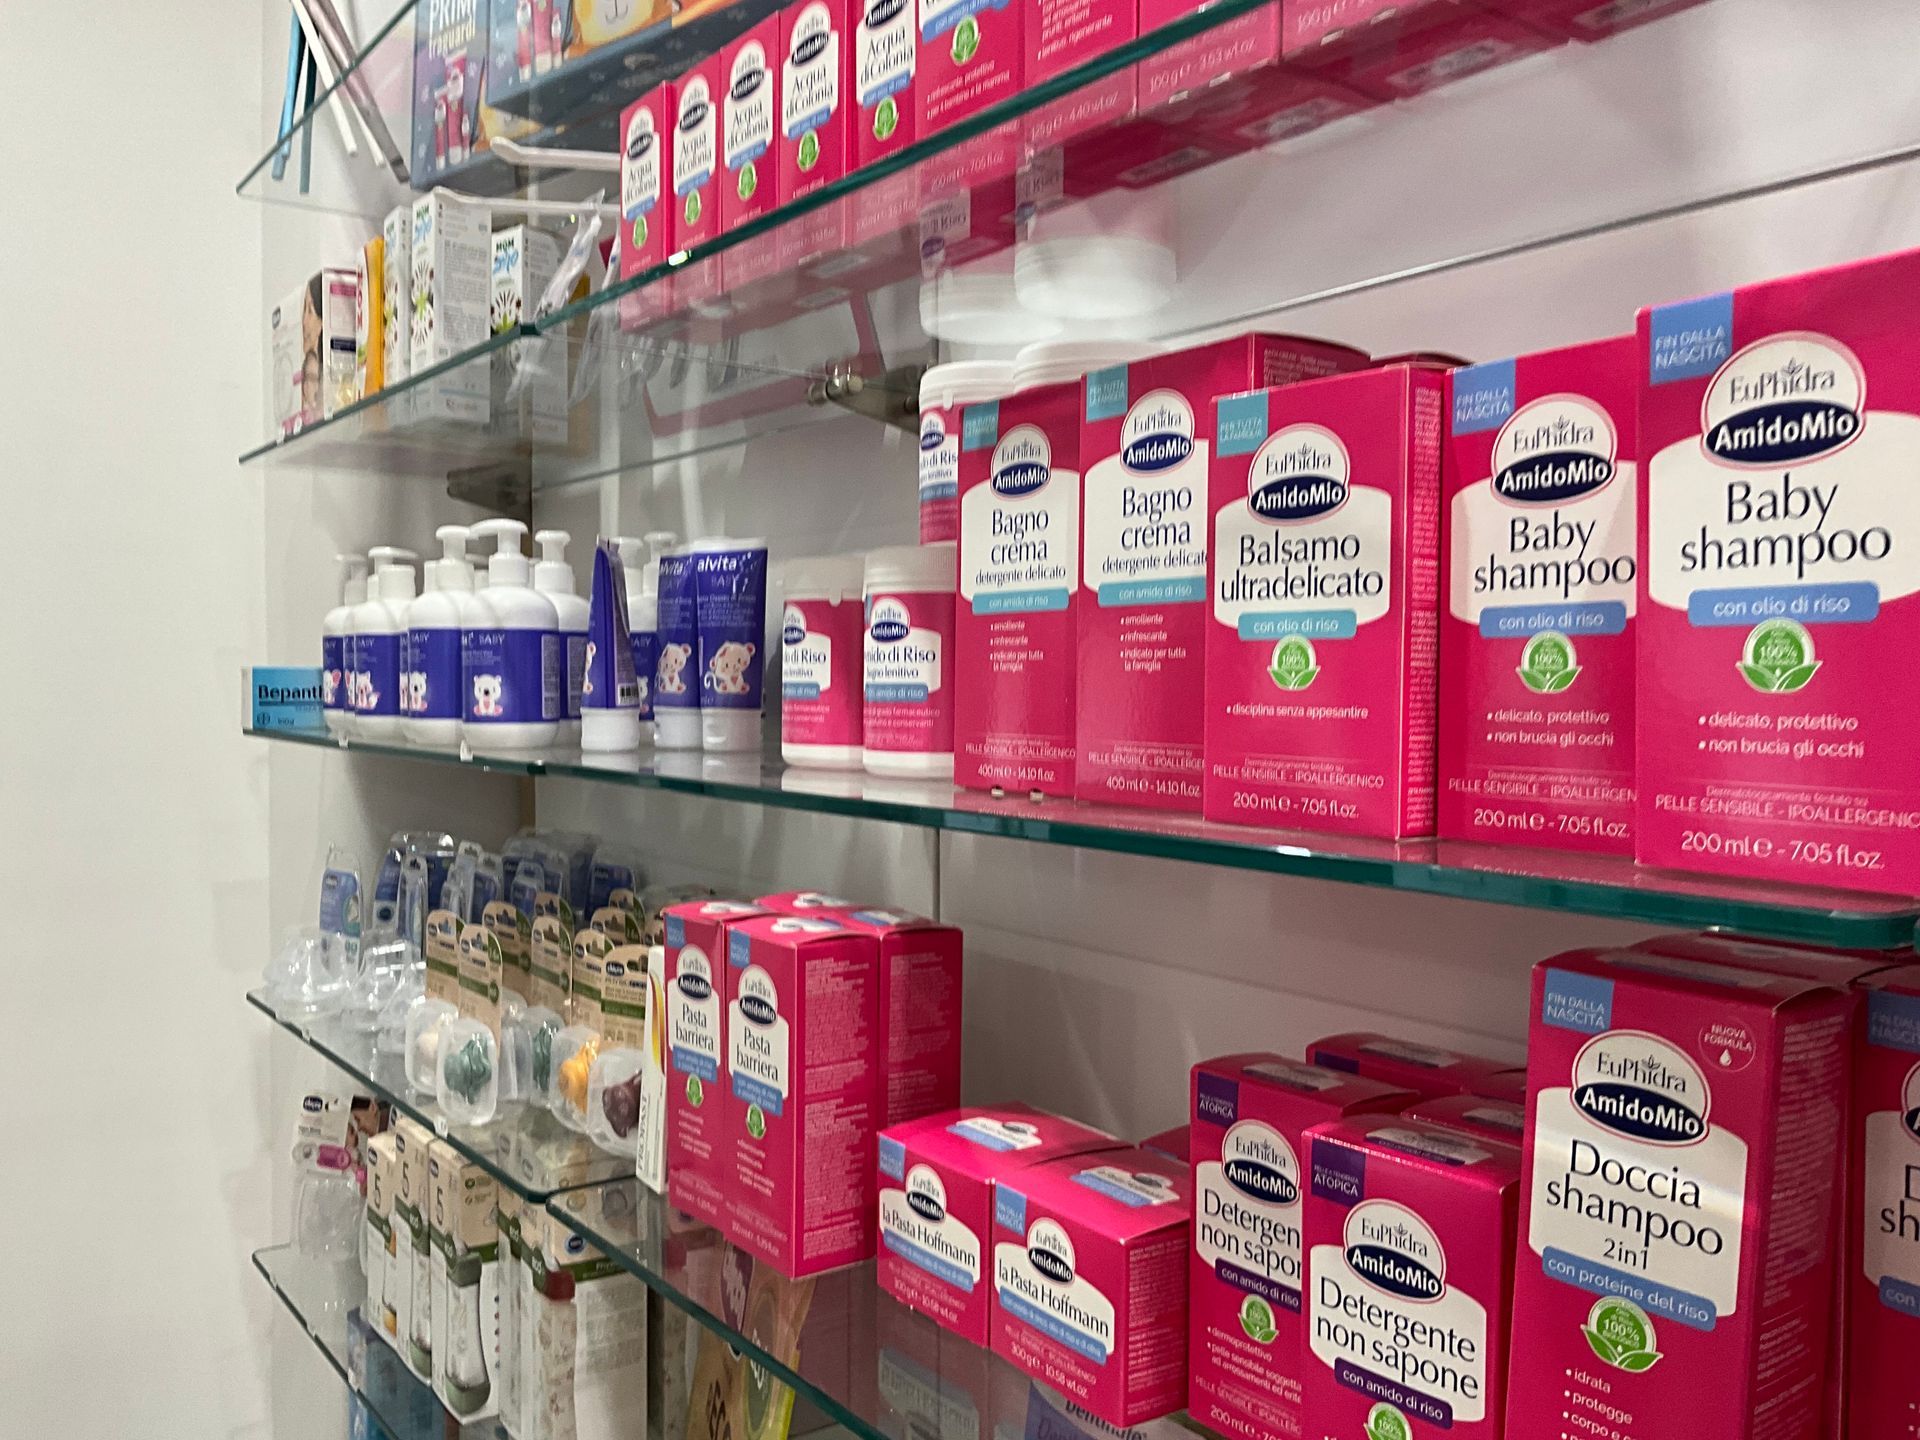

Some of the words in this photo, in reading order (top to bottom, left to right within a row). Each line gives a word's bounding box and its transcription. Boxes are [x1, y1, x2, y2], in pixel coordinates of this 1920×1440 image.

[867, 26, 906, 58] Acqua
[870, 45, 912, 79] Colonia
[793, 65, 827, 96] Acqua
[794, 83, 833, 112] Colonia
[734, 100, 762, 128] Acqua
[682, 133, 707, 157] Acqua
[1679, 325, 1725, 346] DALLA
[1655, 343, 1726, 369] NASCITA
[1730, 363, 1836, 404] EuPhidra
[1456, 402, 1510, 422] NASCITA
[1513, 418, 1594, 453] EuPhidra
[1713, 407, 1855, 453] AmidoMio
[1126, 436, 1191, 464] AmidoMio
[1266, 447, 1331, 476] EuPhidra
[995, 466, 1048, 491] AmidoMio
[1501, 458, 1608, 494] AmidoMio
[1122, 486, 1193, 523] Bagno
[1255, 481, 1343, 512] AmidoMio
[1727, 472, 1839, 531] Baby
[992, 507, 1049, 543] Bagno
[1121, 520, 1191, 551] crema
[1510, 509, 1597, 560] Baby
[991, 539, 1047, 566] crema
[1240, 529, 1360, 567] Balsamo
[1680, 525, 1892, 580] shampoo
[660, 560, 683, 576] alvita
[698, 555, 737, 573] alvita
[975, 567, 1023, 588] detergente
[1024, 563, 1066, 581] delicato
[1102, 555, 1161, 577] detergente
[1474, 553, 1636, 600] shampoo
[1221, 563, 1383, 602] ultradelicato
[1713, 602, 1746, 618] con
[1751, 597, 1786, 615] olio
[1790, 596, 1808, 614] di
[1813, 594, 1851, 614] riso
[1253, 622, 1275, 634] con
[1277, 618, 1299, 632] olio
[1301, 617, 1313, 631] di
[1316, 618, 1339, 631] riso
[1499, 615, 1525, 631] con
[1528, 612, 1554, 629] olio
[1557, 612, 1572, 627] di
[1576, 611, 1604, 627] riso
[479, 632, 505, 645] BABY
[1125, 630, 1168, 642] rinfrescante
[801, 647, 827, 664] Riso
[888, 645, 900, 663] di
[903, 645, 936, 664] Riso
[884, 667, 919, 679] lenitivo
[1232, 703, 1275, 717] disciplina
[1276, 706, 1305, 717] senza
[1306, 706, 1369, 720] appesantire
[1546, 709, 1610, 727] protettivo
[1708, 712, 1774, 730] delicato,
[1777, 713, 1859, 732] protettivo
[1494, 732, 1517, 744] non
[1519, 730, 1557, 745] brucia
[1578, 731, 1614, 747] occhi
[1708, 740, 1738, 753] non
[1741, 737, 1789, 755] brucia
[1793, 739, 1815, 760] gli
[1817, 739, 1865, 759] occhi
[1088, 751, 1111, 764] PELLE
[1106, 776, 1127, 792] 400
[1213, 765, 1239, 778] PELLE
[1241, 767, 1288, 782] SENSIBILE
[1295, 771, 1385, 788] IPOALLERGENICO
[1449, 778, 1482, 791] PELLE
[1484, 780, 1538, 796] SENSIBILE
[1233, 793, 1259, 809] 200
[1655, 794, 1697, 810] PELLE
[1700, 796, 1774, 816] SENSIBILE
[1474, 808, 1505, 827] 200
[1681, 830, 1721, 853] 200
[682, 1003, 708, 1029] Pasta
[741, 997, 776, 1023] AmidoMio
[1547, 1005, 1606, 1028] NASCITA
[1567, 997, 1605, 1016] DALLA
[675, 1020, 714, 1052] barriera
[744, 1025, 771, 1056] Pasta
[1704, 1034, 1753, 1054] FORMULA
[1710, 1023, 1746, 1039] NUOVA
[736, 1044, 779, 1082] barriera
[1597, 1051, 1687, 1094] EuPhidra
[1199, 1099, 1234, 1120] ATOPICA
[1581, 1087, 1700, 1136] AmidoMio
[1236, 1137, 1287, 1168] EuPhidra
[1228, 1164, 1295, 1201] AmidoMio
[1313, 1174, 1359, 1198] ATOPICA
[1570, 1138, 1702, 1210] Doccia
[908, 1193, 944, 1219] AmidoMio
[1203, 1188, 1300, 1250] Detergen
[1546, 1173, 1724, 1257] shampoo
[881, 1203, 891, 1224] la
[892, 1209, 916, 1238] Pasta
[917, 1224, 976, 1269] Hoffmann
[1201, 1222, 1240, 1255] non
[1361, 1217, 1428, 1258] EuPhidra
[1030, 1250, 1072, 1281] AmidoMio
[1602, 1237, 1649, 1271] 2in1
[1351, 1247, 1440, 1295] AmidoMio
[1221, 1268, 1238, 1283] con
[1238, 1273, 1269, 1295] amido
[1281, 1290, 1299, 1308] riso
[1547, 1256, 1575, 1275] con
[1579, 1266, 1644, 1301] proteine
[1647, 1288, 1674, 1311] del
[1678, 1300, 1709, 1323] riso
[1010, 1270, 1039, 1300] Pasta
[1041, 1286, 1109, 1338] Hoffmann
[1320, 1275, 1477, 1363] Detergente
[1603, 1318, 1640, 1343] 100%
[1211, 1326, 1273, 1363] dermoprotettivo
[1317, 1314, 1366, 1356] non
[1372, 1337, 1480, 1400] sapone
[1222, 1361, 1271, 1390] arrossamenti
[1574, 1368, 1611, 1394] idrata
[1343, 1370, 1364, 1389] con
[1366, 1378, 1403, 1404] amido
[1405, 1395, 1418, 1411] di
[1420, 1402, 1443, 1421] riso
[1572, 1392, 1633, 1425] protegge
[1571, 1413, 1609, 1437] corpo
